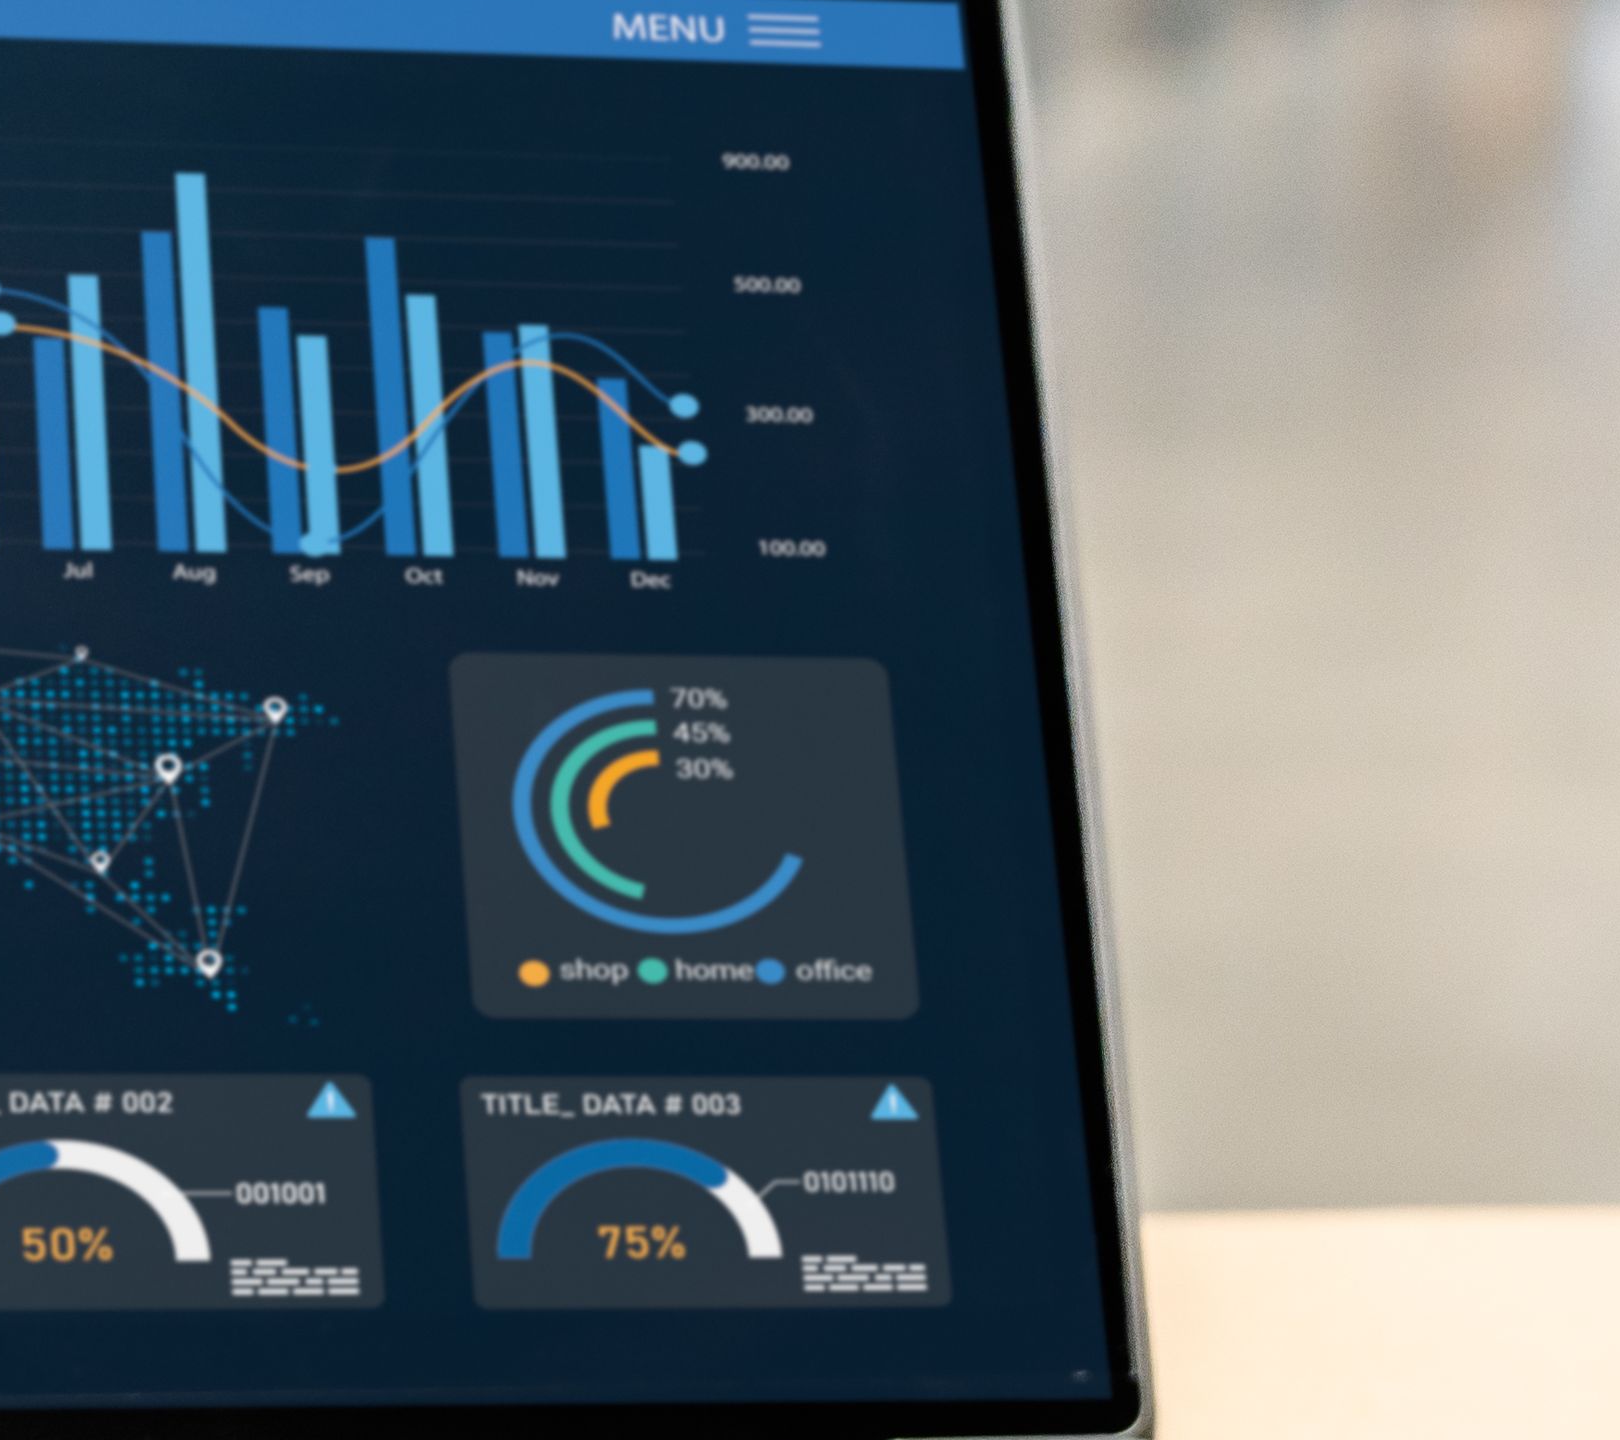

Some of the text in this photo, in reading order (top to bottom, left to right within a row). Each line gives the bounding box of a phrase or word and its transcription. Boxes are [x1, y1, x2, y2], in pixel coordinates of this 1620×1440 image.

[613, 13, 725, 43] MENU
[722, 153, 790, 170] 900.00
[734, 276, 802, 294] 500.00
[747, 406, 814, 423] 300.00
[759, 539, 826, 557] 100.00
[64, 562, 94, 579] Jul
[173, 563, 217, 585] Aug
[289, 565, 330, 586] Sep
[404, 566, 443, 585] Oct
[516, 569, 559, 586] Nov
[630, 570, 670, 588] Dec
[671, 687, 728, 709] 70%
[674, 722, 730, 743] 45%
[676, 758, 734, 779] 30%
[560, 958, 629, 985] shop
[675, 959, 754, 982] home
[796, 959, 872, 981] office
[9, 1091, 85, 1113] DATA
[94, 1093, 112, 1112] #
[122, 1091, 173, 1114] 002
[481, 1093, 741, 1118] TITLE_ DATA # 003
[803, 1170, 895, 1193] 0101110
[235, 1182, 326, 1205] 001001
[22, 1227, 113, 1262] 50%
[598, 1225, 686, 1259] 75%
